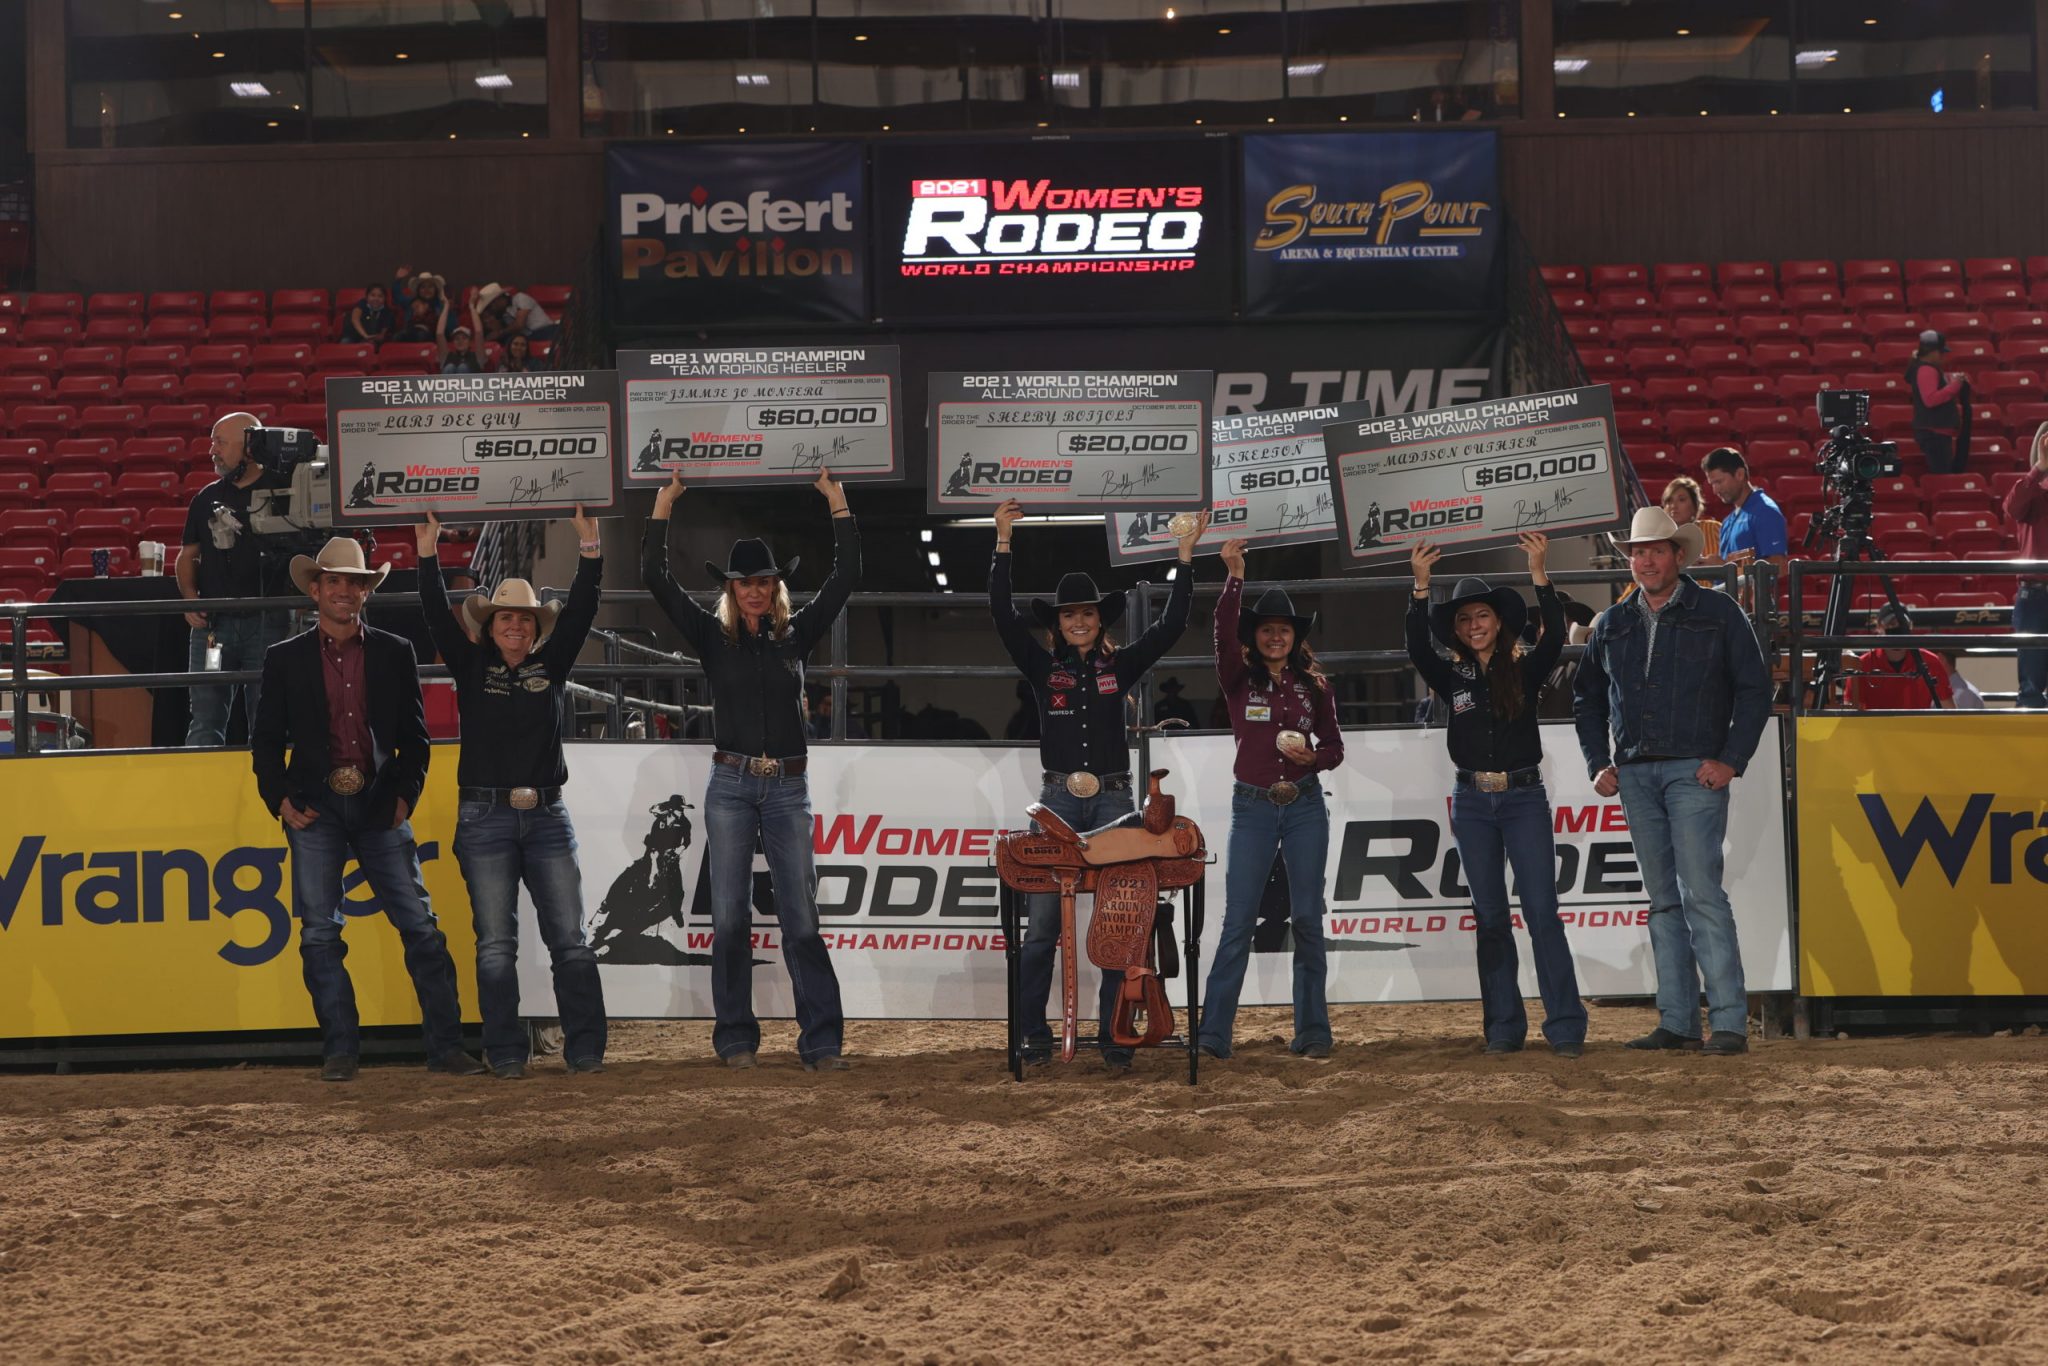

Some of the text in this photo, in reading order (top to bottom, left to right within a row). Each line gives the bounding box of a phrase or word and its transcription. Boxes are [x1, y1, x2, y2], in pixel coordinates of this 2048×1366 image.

[919, 181, 979, 195] 2021
[992, 179, 1203, 211] WOMEN'S
[620, 185, 852, 236] Priefert
[1253, 180, 1491, 252] SOUTH POINT
[902, 196, 1203, 256] RODEO
[621, 236, 853, 280] Pavilion
[1279, 245, 1460, 260] ARENA & EQUESTRIAN CENTER
[901, 260, 1196, 276] WORLD CHAMPIONSHIP
[650, 349, 866, 365] 2021 WORLD CHAMPION
[670, 361, 848, 376] TEAM ROPING HEELER
[362, 375, 585, 394] 2021 WORLD CHAMPION
[963, 375, 1178, 388] 2021 WORLD CHAMPION
[381, 388, 567, 406] TEAM ROPING HEADER
[981, 387, 1160, 399] ALL-AROUND COWGIRL
[1290, 368, 1490, 417] TIME
[441, 413, 475, 427] DEE
[481, 411, 522, 430] GUY
[758, 407, 877, 428] $60,000
[1212, 406, 1339, 431] RLD CHAMPION
[1358, 393, 1579, 436] 2021 WORLD CHAMPION
[287, 431, 295, 440] 5
[1212, 424, 1296, 442] REL RACER
[1390, 410, 1550, 443] BREAKAWAY ROPER
[691, 431, 764, 444] WOMEN'S
[1068, 434, 1188, 455] $20,000
[474, 437, 597, 460] $60,000
[661, 438, 763, 460] RODEO
[406, 464, 480, 478] WOMEN'S
[1001, 456, 1073, 468] WOMEN'S
[1475, 454, 1596, 487] $60,000
[375, 471, 480, 495] RODEO
[971, 463, 1073, 484] RODEO
[1240, 467, 1331, 492] $60,00
[1212, 498, 1248, 509] EN'S
[1409, 495, 1483, 513] WOMEN'S
[1151, 507, 1248, 532] REO
[1382, 504, 1484, 533] RODEO
[1099, 680, 1117, 688] MVP
[814, 814, 1008, 856] WOME
[1110, 878, 1147, 889] 2021
[1103, 901, 1147, 913] AROUND
[1102, 913, 1142, 923] WORLD
[1331, 915, 1446, 935] WORLD
[822, 933, 1009, 951] CHAMPIONS
